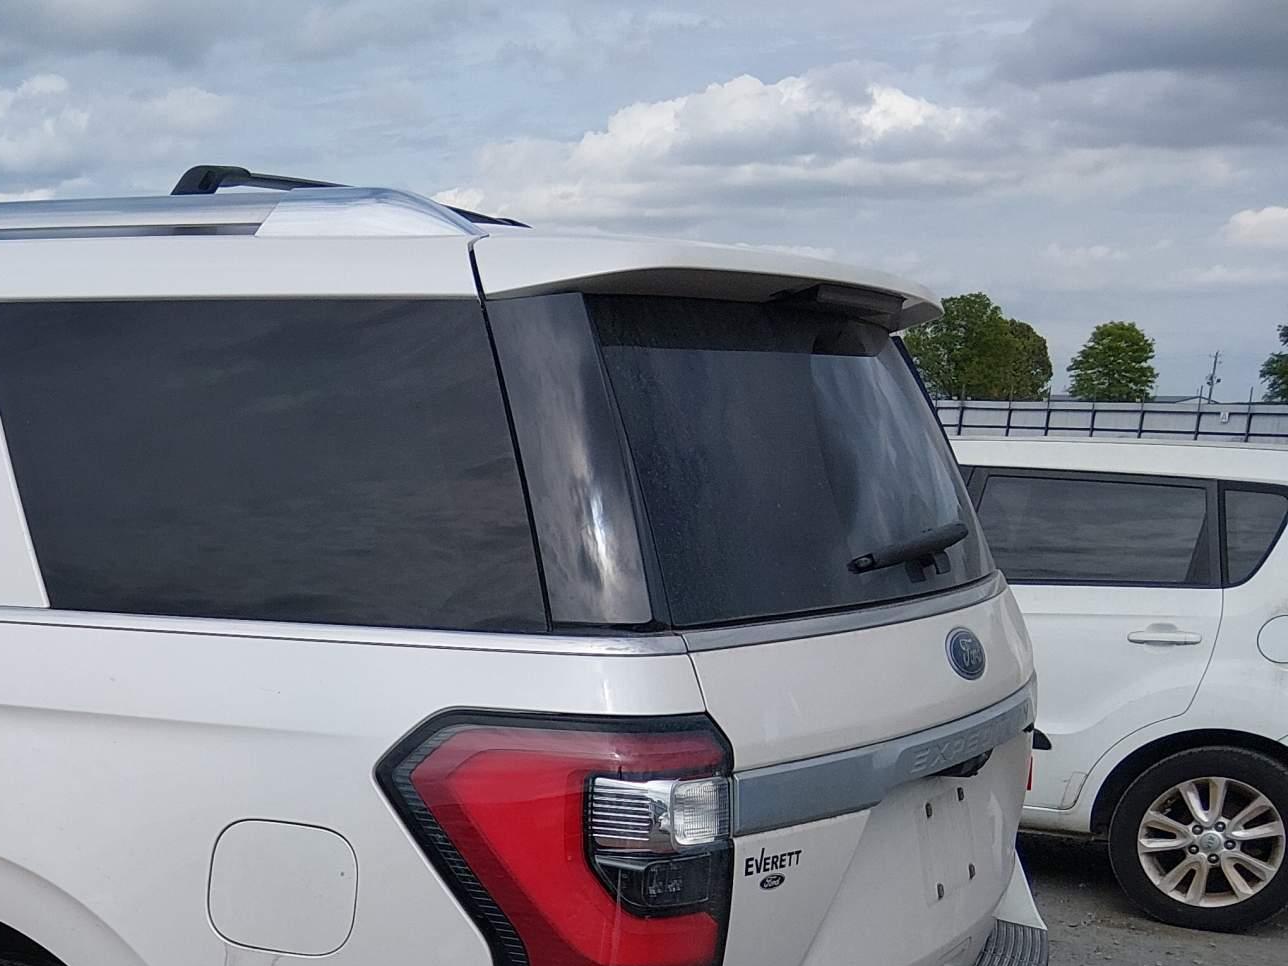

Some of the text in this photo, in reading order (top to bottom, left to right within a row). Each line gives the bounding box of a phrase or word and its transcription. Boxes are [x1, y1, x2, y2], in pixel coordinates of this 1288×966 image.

[955, 636, 985, 669] Ford
[744, 847, 802, 877] EVERETT
[762, 875, 783, 888] Ford
